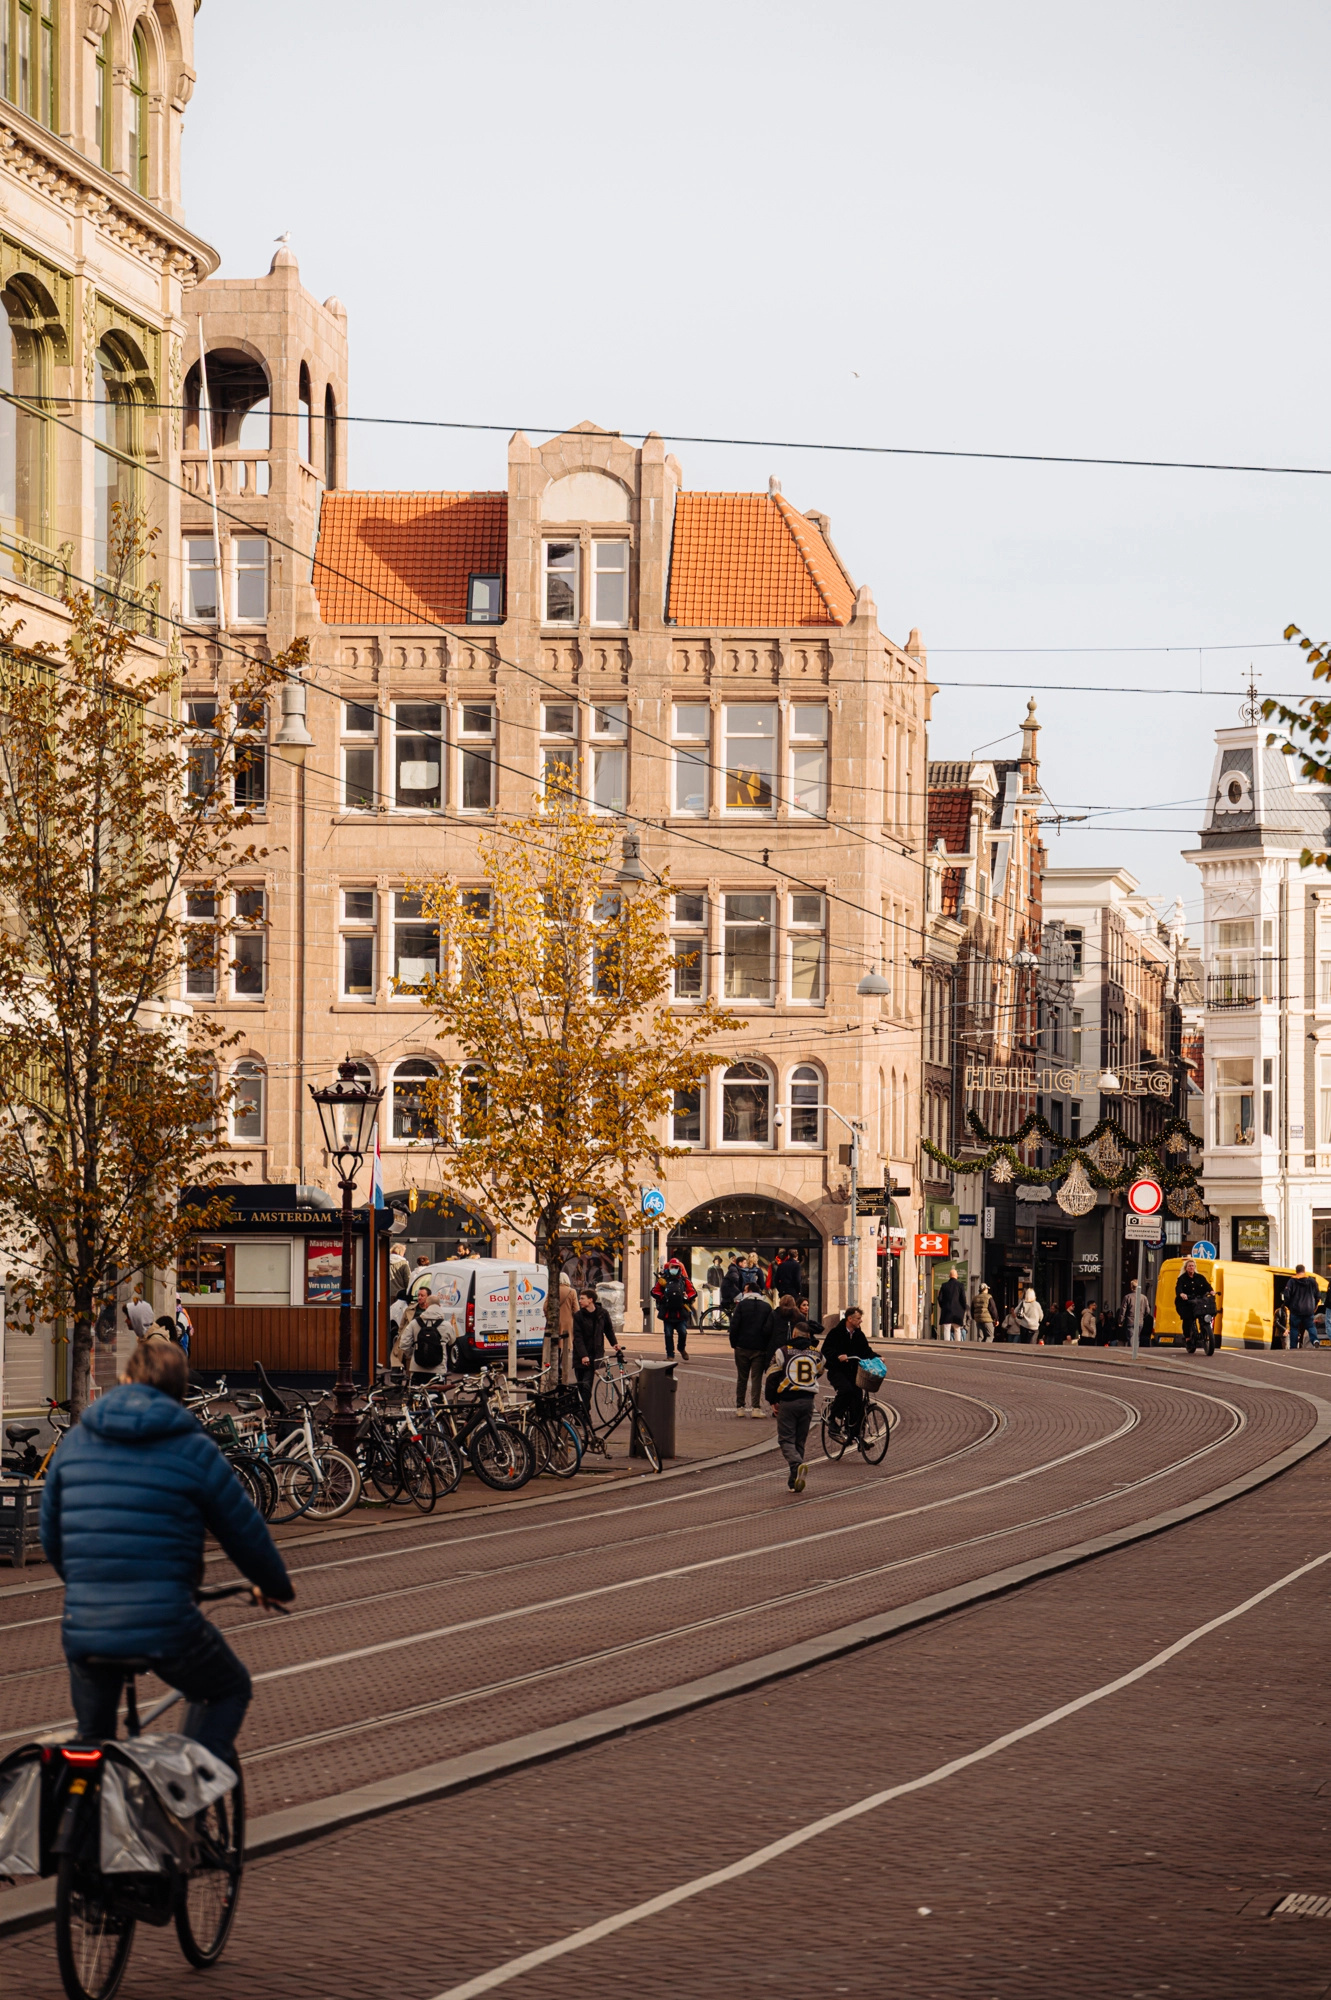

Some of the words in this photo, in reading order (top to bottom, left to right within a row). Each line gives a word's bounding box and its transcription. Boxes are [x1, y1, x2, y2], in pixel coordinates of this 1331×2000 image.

[251, 1212, 333, 1223] AMSTERDAM
[309, 1240, 333, 1249] Maatjes
[1082, 1253, 1099, 1263] IQOS
[1079, 1264, 1101, 1273] STORE
[331, 1282, 340, 1290] het
[489, 1294, 523, 1303] BOUA
[797, 1361, 813, 1383] B
